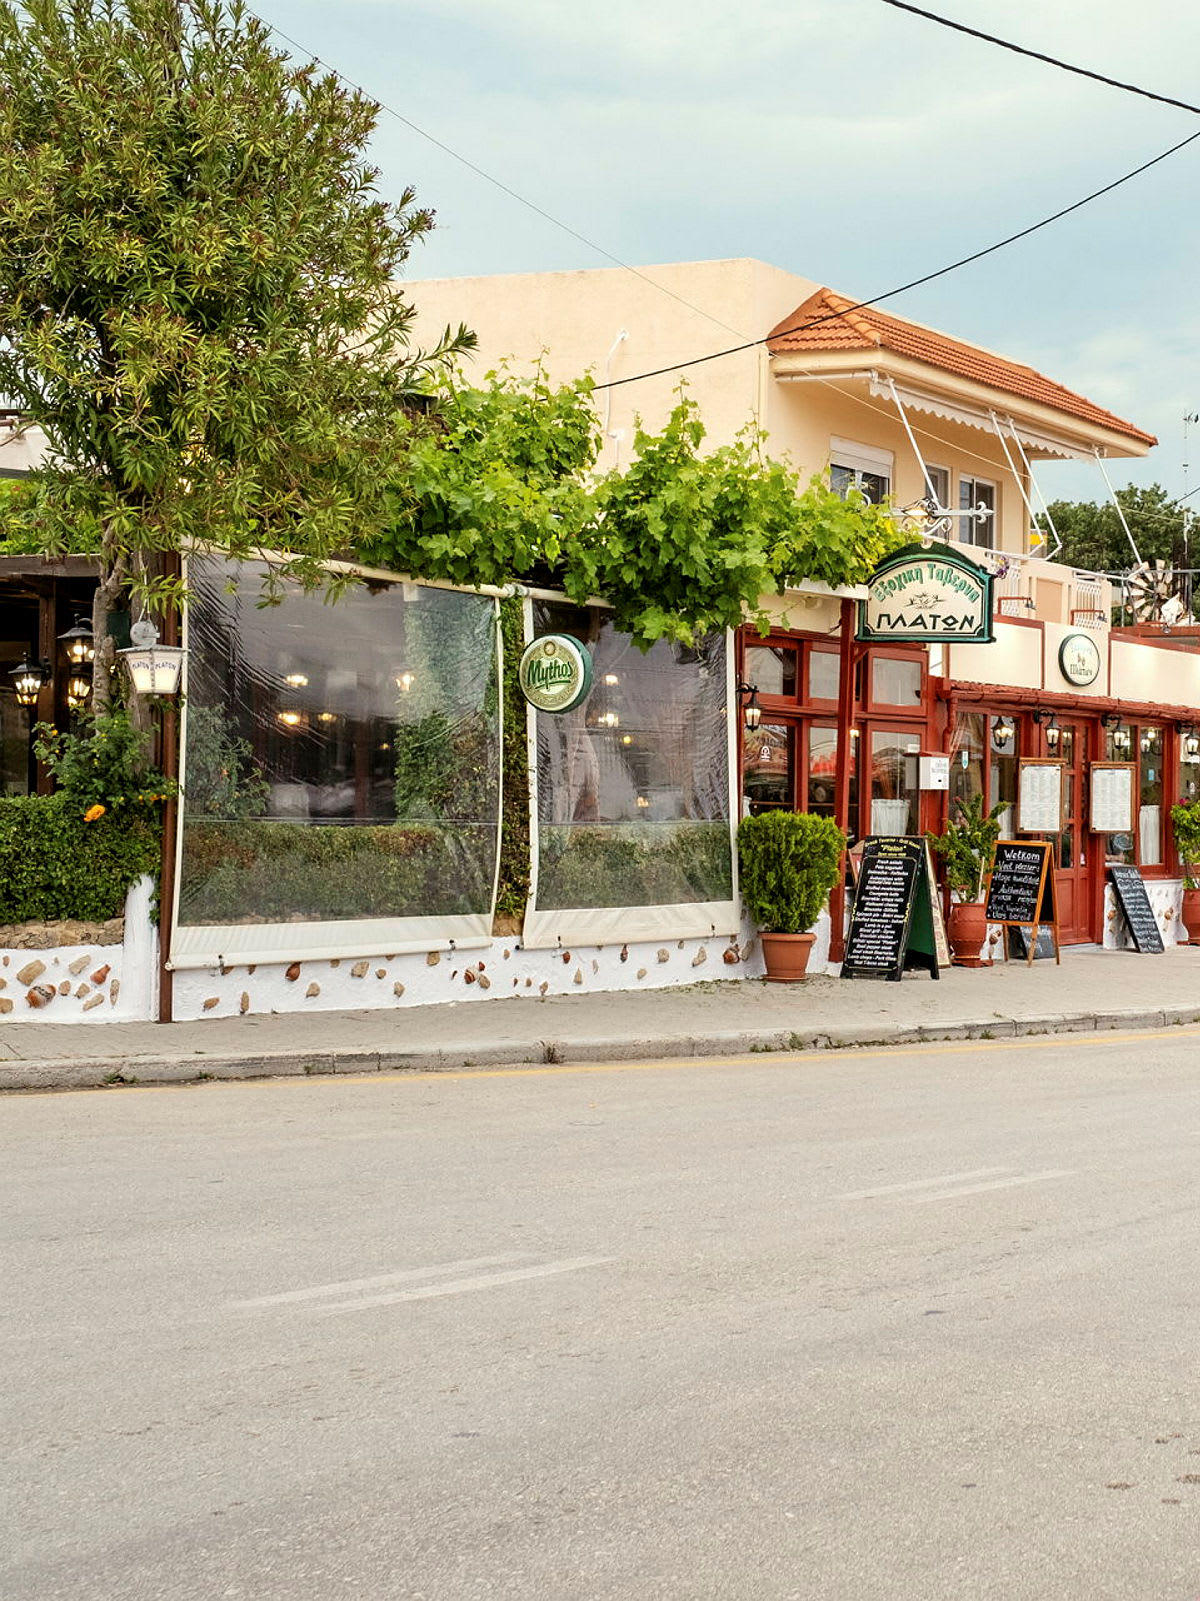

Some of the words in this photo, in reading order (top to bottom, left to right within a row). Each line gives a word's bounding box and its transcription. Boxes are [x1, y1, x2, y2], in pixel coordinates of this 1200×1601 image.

[876, 613, 975, 631] ΠΛΑΤΩΝ
[155, 661, 176, 671] PLATON
[527, 659, 574, 690] Mythos
[1004, 849, 1040, 860] Welkom
